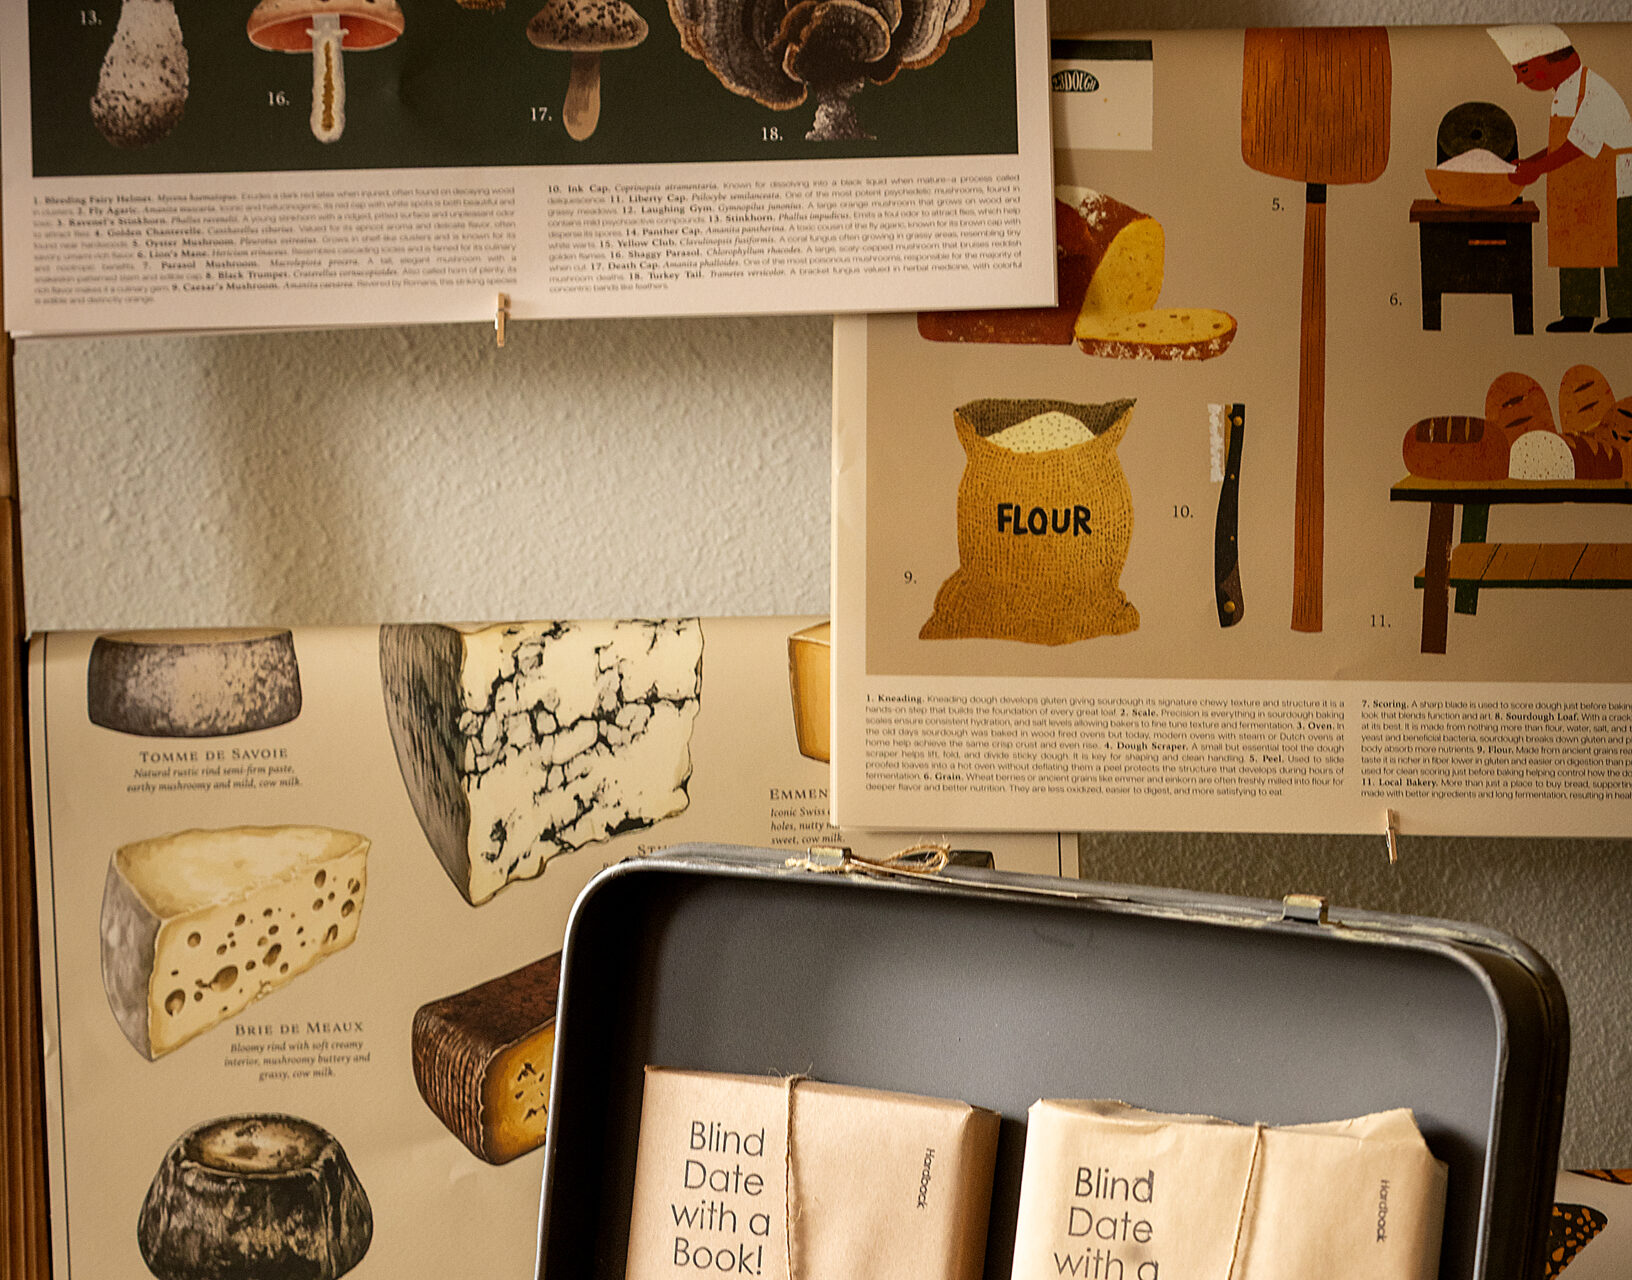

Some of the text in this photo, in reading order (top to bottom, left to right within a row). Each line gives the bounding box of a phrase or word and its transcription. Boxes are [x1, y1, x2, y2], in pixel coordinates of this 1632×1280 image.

[81, 10, 101, 25] 13.
[267, 91, 290, 106] 16.
[531, 107, 552, 121] 17.
[761, 127, 783, 141] 18.
[567, 184, 610, 193] Ink Cap.
[667, 194, 687, 203] Cap.
[1272, 198, 1284, 211] 5.
[642, 205, 685, 215] Laughing
[628, 250, 661, 260] Shaggy
[608, 261, 660, 271] Death Cap.
[650, 272, 679, 281] Turkey
[1390, 293, 1402, 305] 6.
[1172, 505, 1193, 518] 10.
[998, 503, 1092, 536] FLOUR
[904, 571, 916, 584] 9.
[1371, 614, 1390, 628] 11.
[867, 694, 924, 703] 1. Kneading.
[1362, 700, 1409, 710] 7. Scoring.
[1132, 709, 1159, 717] Scale.
[1494, 712, 1580, 723] 8. Sourdough Loaf.
[1297, 722, 1305, 730] 3.
[1117, 742, 1148, 751] Dough
[1151, 743, 1189, 752] Scraper.
[1477, 746, 1514, 754] 9. Flour.
[1250, 754, 1284, 763] 5. Peel.
[134, 768, 170, 778] Natural
[173, 767, 198, 777] rustic
[201, 766, 220, 776] rind
[935, 772, 964, 780] Grain.
[127, 780, 155, 793] earthy
[159, 780, 210, 792] mushroomy
[213, 779, 230, 789] and
[259, 779, 277, 787] cow
[280, 777, 303, 787] milk.
[1361, 778, 1439, 788] 11. Local Bakery.
[771, 807, 796, 817] Iconic
[800, 806, 825, 817] Swiss
[771, 821, 796, 831] holes,
[800, 822, 823, 832] nutty
[772, 832, 845, 845] sweet, cow milk.
[230, 1040, 363, 1054] Bloomy rind with soft creamy
[224, 1052, 370, 1067] interior, mushroomy buttery and
[259, 1067, 335, 1082] grassy, cow milk.
[690, 1121, 765, 1157] Blind
[684, 1159, 764, 1196] Date
[917, 1148, 935, 1210] Hardback
[1075, 1167, 1154, 1203] Blind
[1376, 1179, 1390, 1243] Hardback
[671, 1200, 771, 1236] with a
[1068, 1206, 1153, 1243] Date
[673, 1237, 763, 1276] Book!
